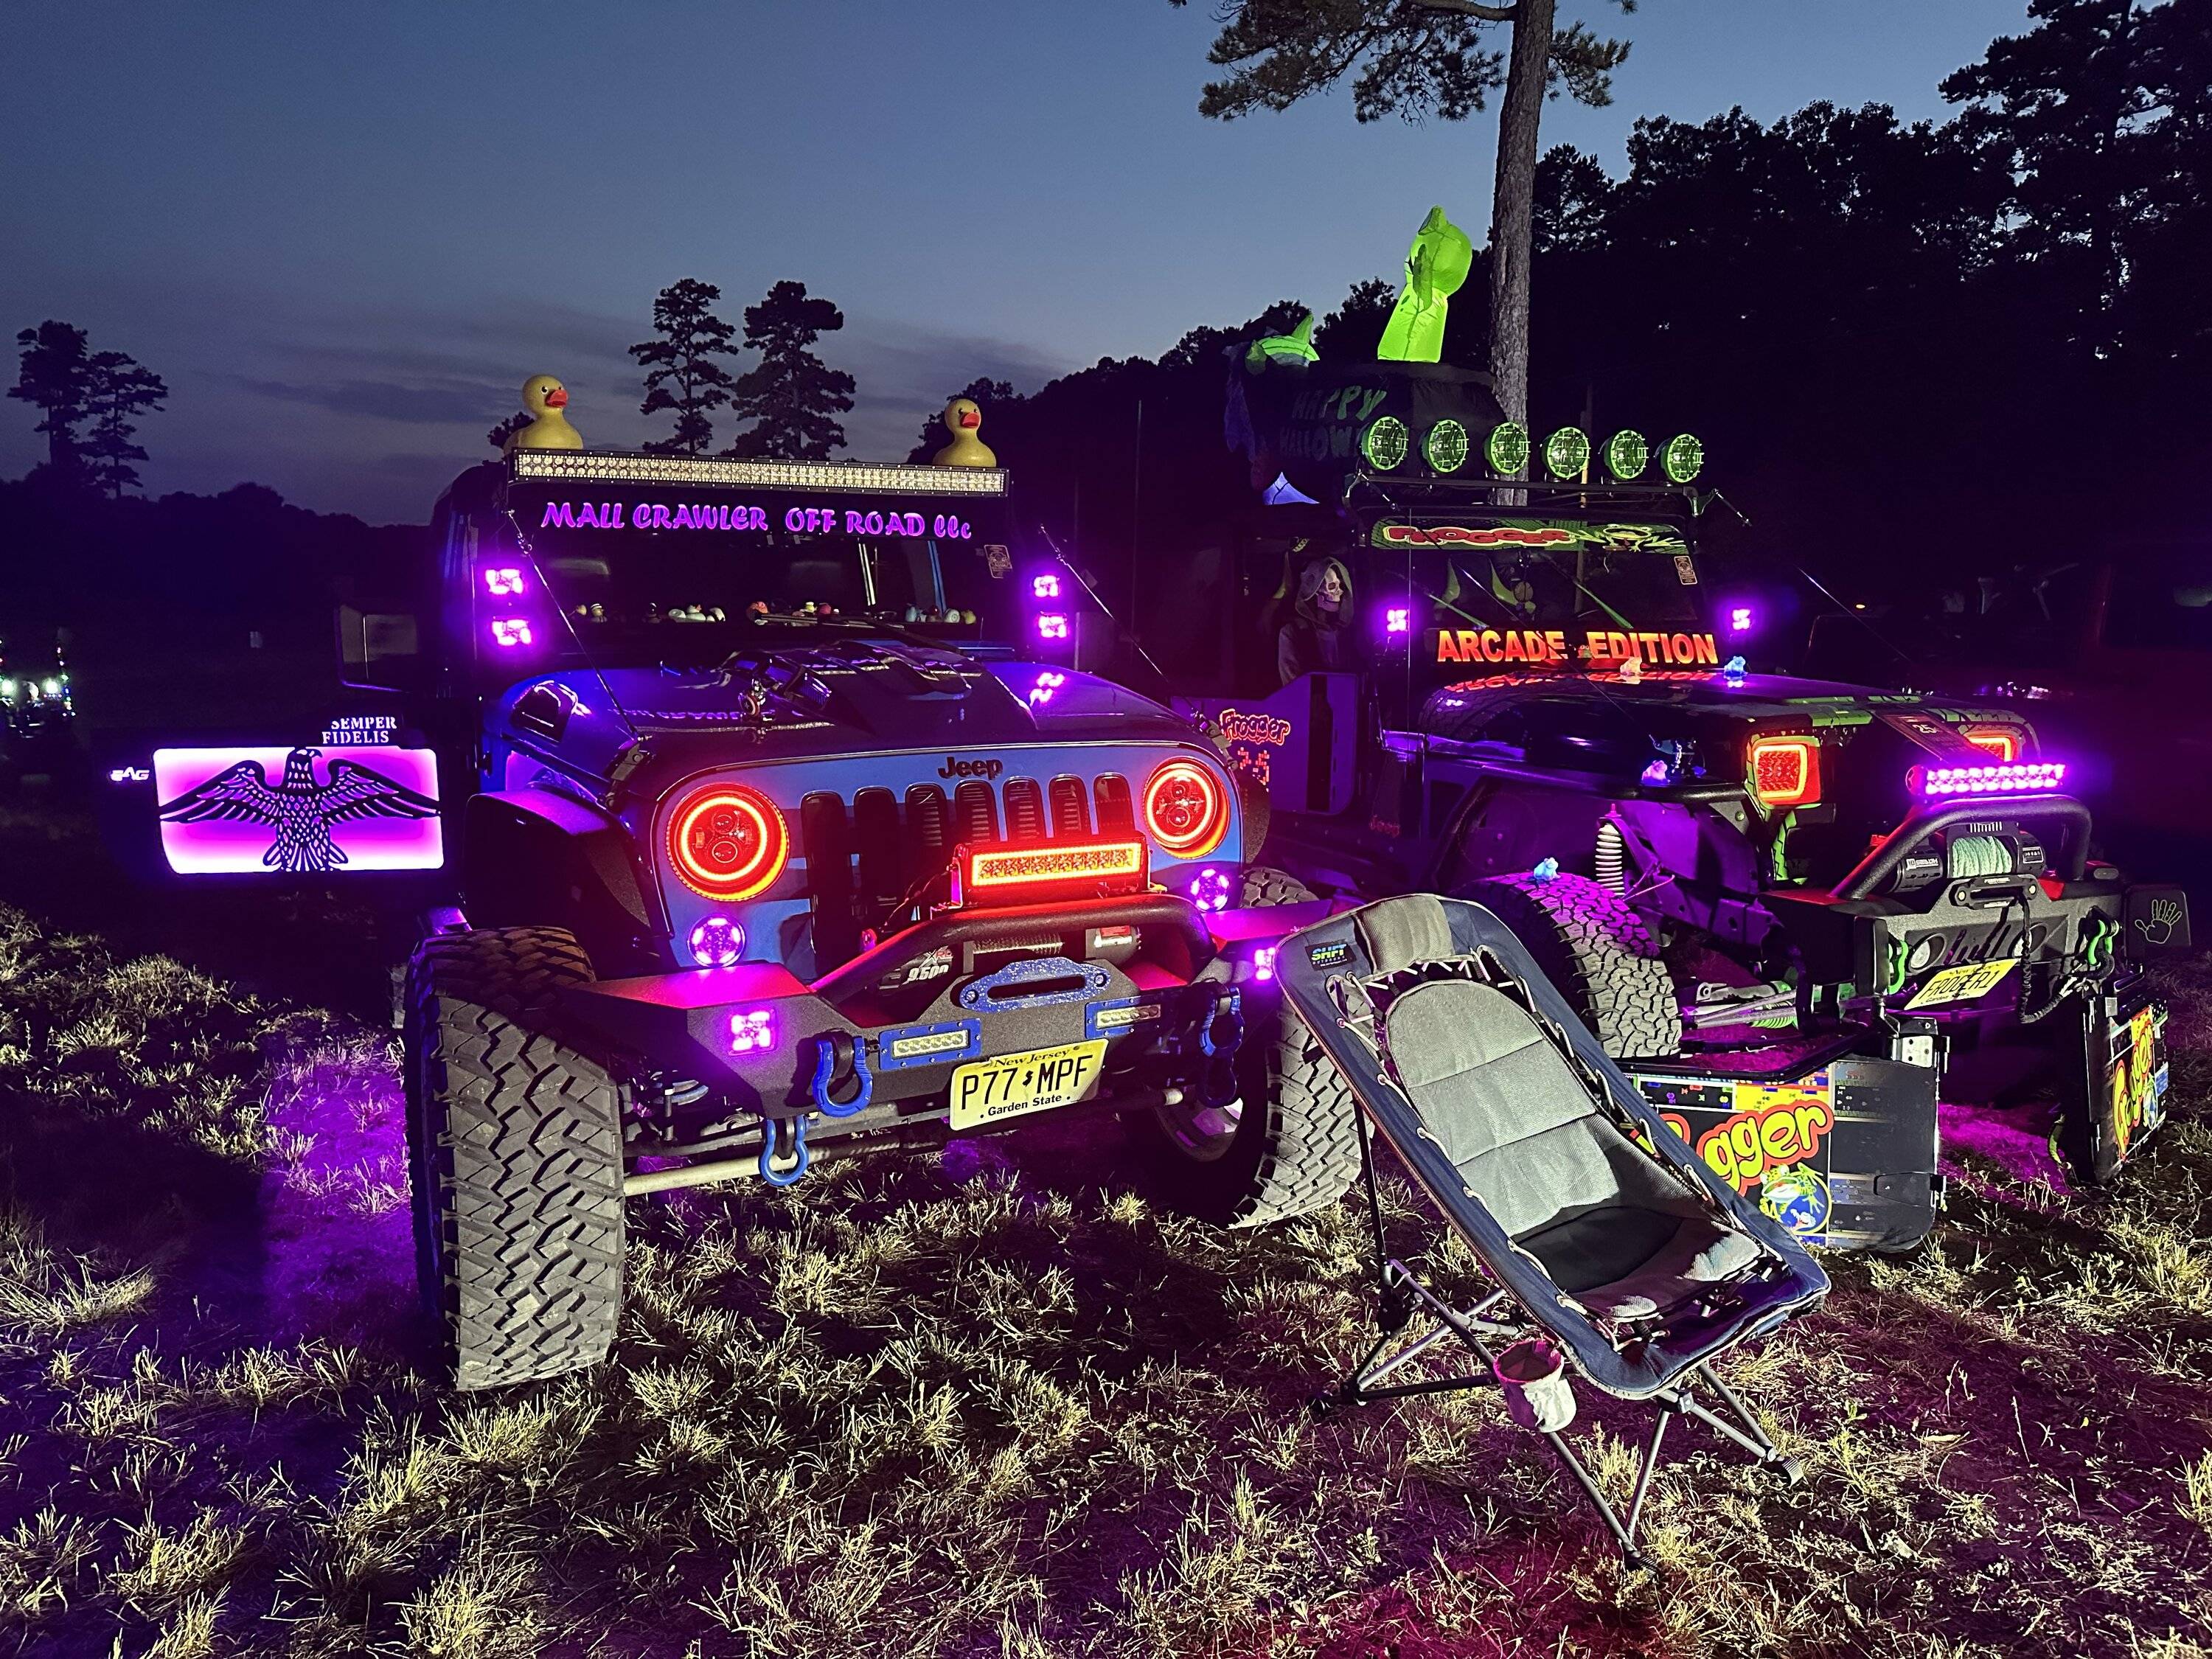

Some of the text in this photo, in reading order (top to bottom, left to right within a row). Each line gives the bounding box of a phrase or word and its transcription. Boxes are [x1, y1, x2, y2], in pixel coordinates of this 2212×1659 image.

[540, 501, 625, 529] MALL
[632, 503, 768, 531] CRAWLER
[785, 507, 837, 534] OFF
[844, 510, 926, 537] ROAD
[1385, 526, 1572, 545] FROGGER
[1437, 630, 1719, 664] ARCADE EDITION
[331, 717, 397, 730] SEMPER
[1220, 709, 1290, 745] Frogger
[321, 731, 389, 744] FIDELIS
[937, 756, 1004, 781] Jeep
[995, 1048, 1070, 1068] New Jersey
[961, 1054, 1093, 1110] P77 MPF
[988, 1094, 1062, 1116] Garden State
[1694, 1101, 1833, 1196] gger
